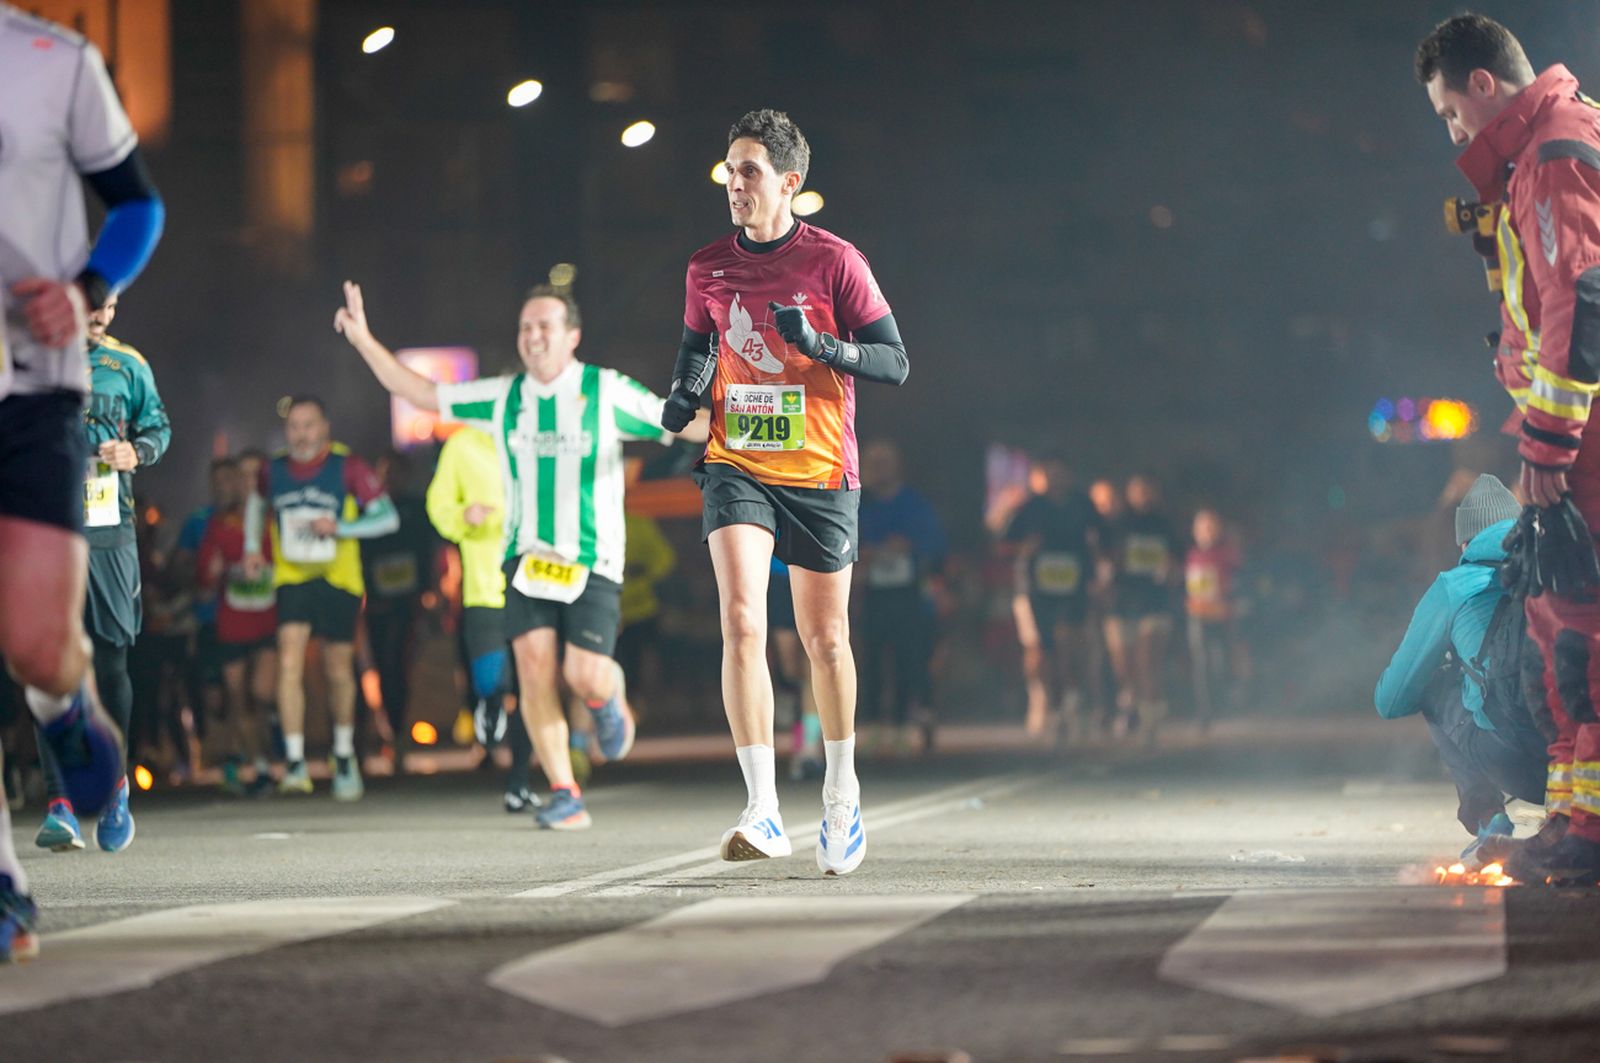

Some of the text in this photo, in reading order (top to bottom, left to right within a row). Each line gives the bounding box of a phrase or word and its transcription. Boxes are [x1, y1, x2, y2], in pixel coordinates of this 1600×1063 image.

[741, 337, 764, 361] 43
[730, 404, 745, 413] SAN
[746, 402, 774, 414] ANTÓN
[763, 395, 774, 404] DE
[737, 415, 790, 441] 9219
